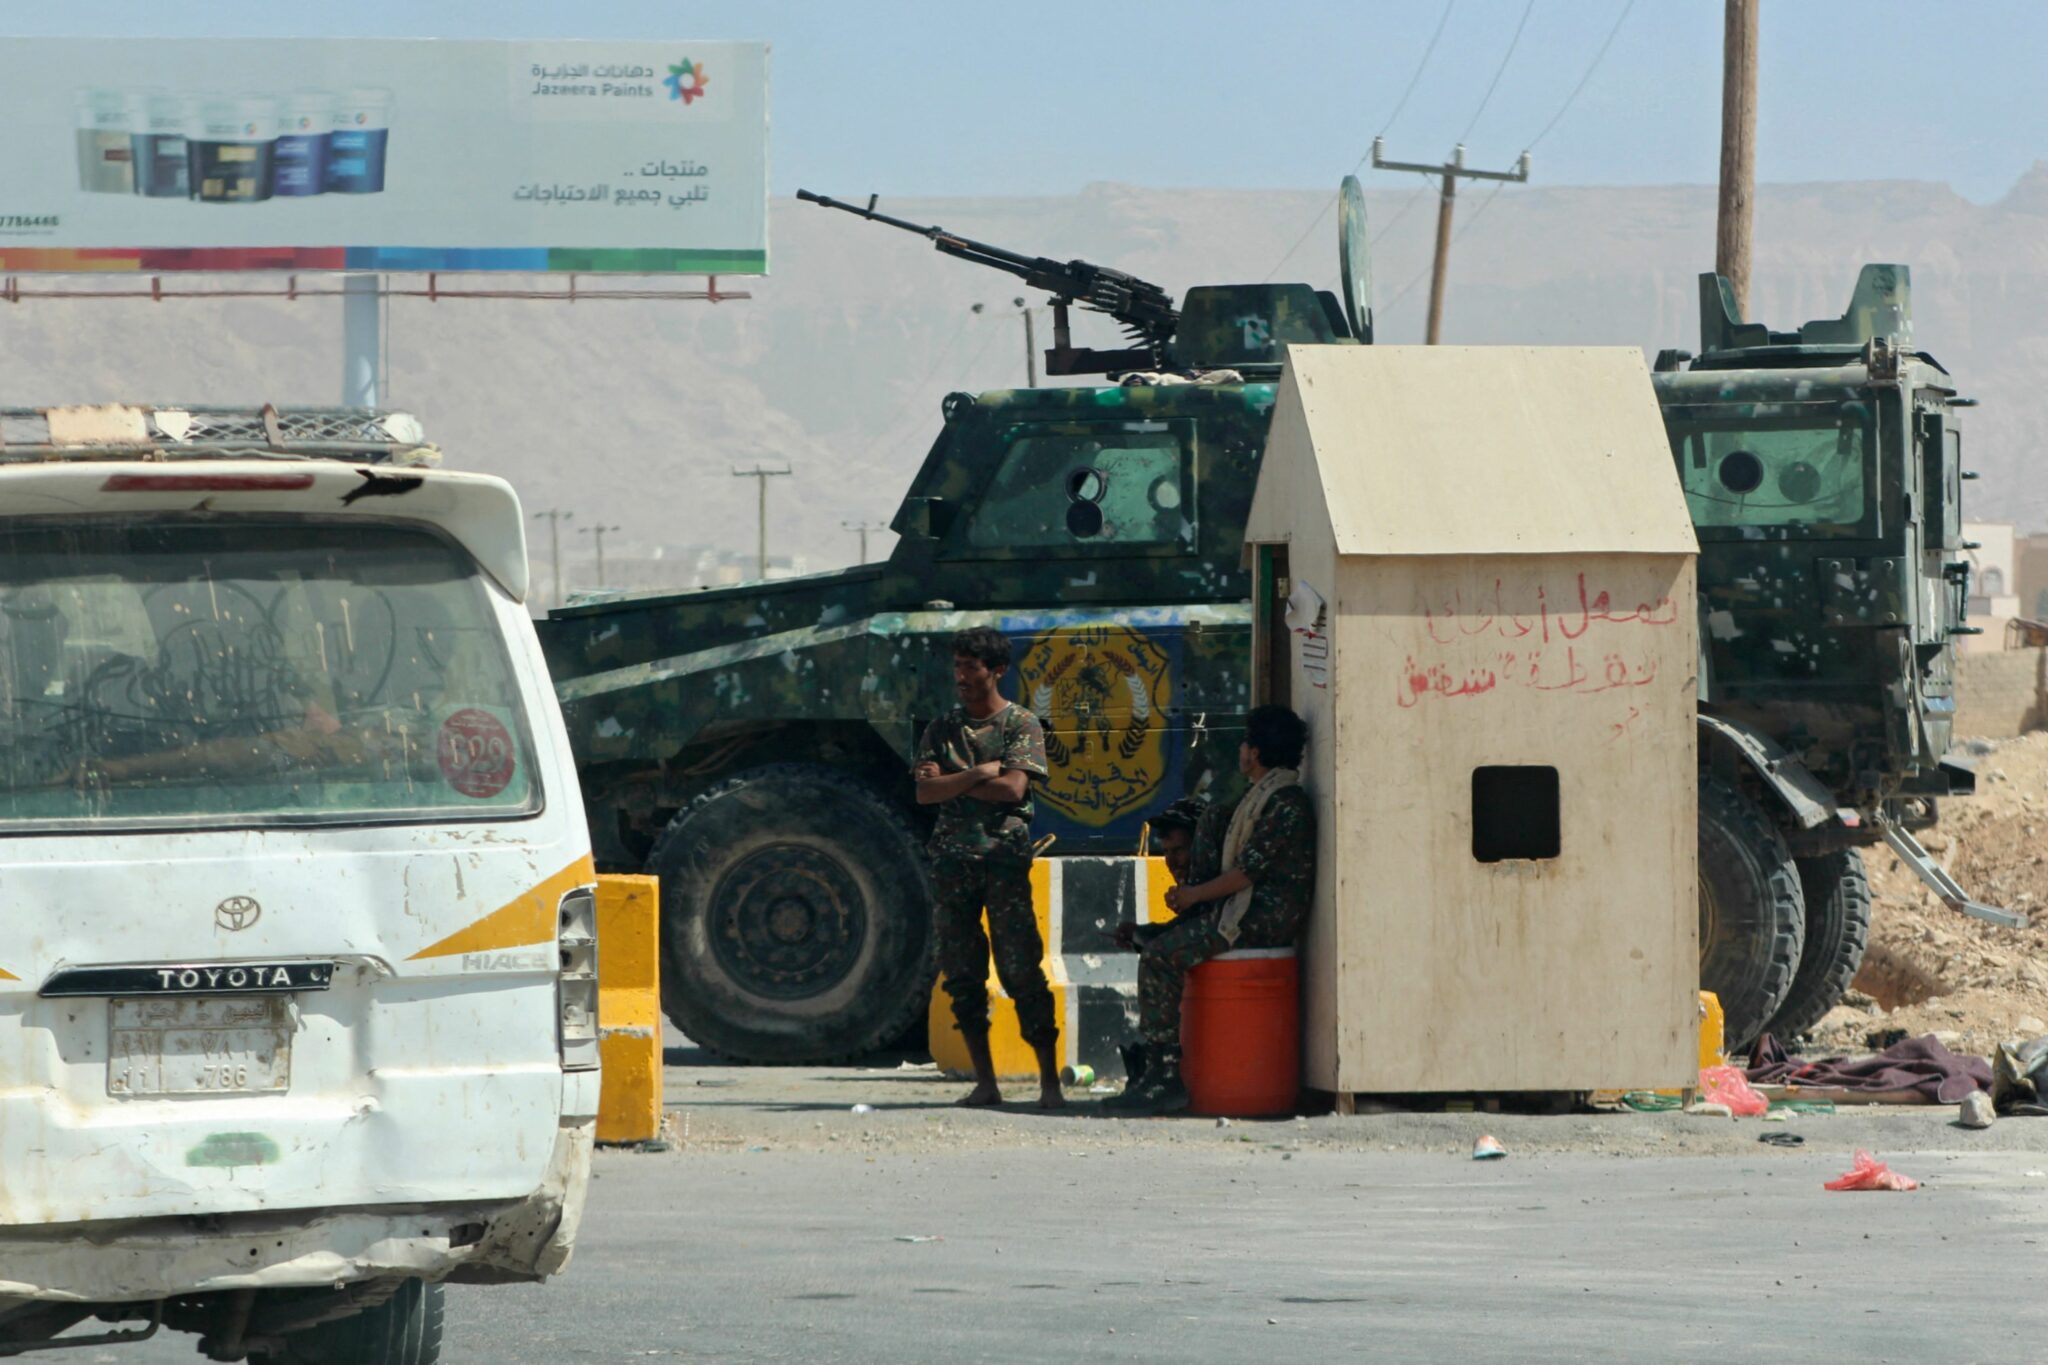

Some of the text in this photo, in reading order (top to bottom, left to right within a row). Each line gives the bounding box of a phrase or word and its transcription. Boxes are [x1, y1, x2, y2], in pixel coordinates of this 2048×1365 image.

[531, 62, 653, 80] دهانات الجزيرة
[532, 82, 653, 97] Jazeera Paints
[640, 160, 709, 181] منتجات
[513, 183, 709, 210] تلبي جميع الاحتياجات
[1069, 625, 1109, 646] الله
[157, 966, 291, 989] TOYOTA
[202, 1065, 248, 1088] 786
